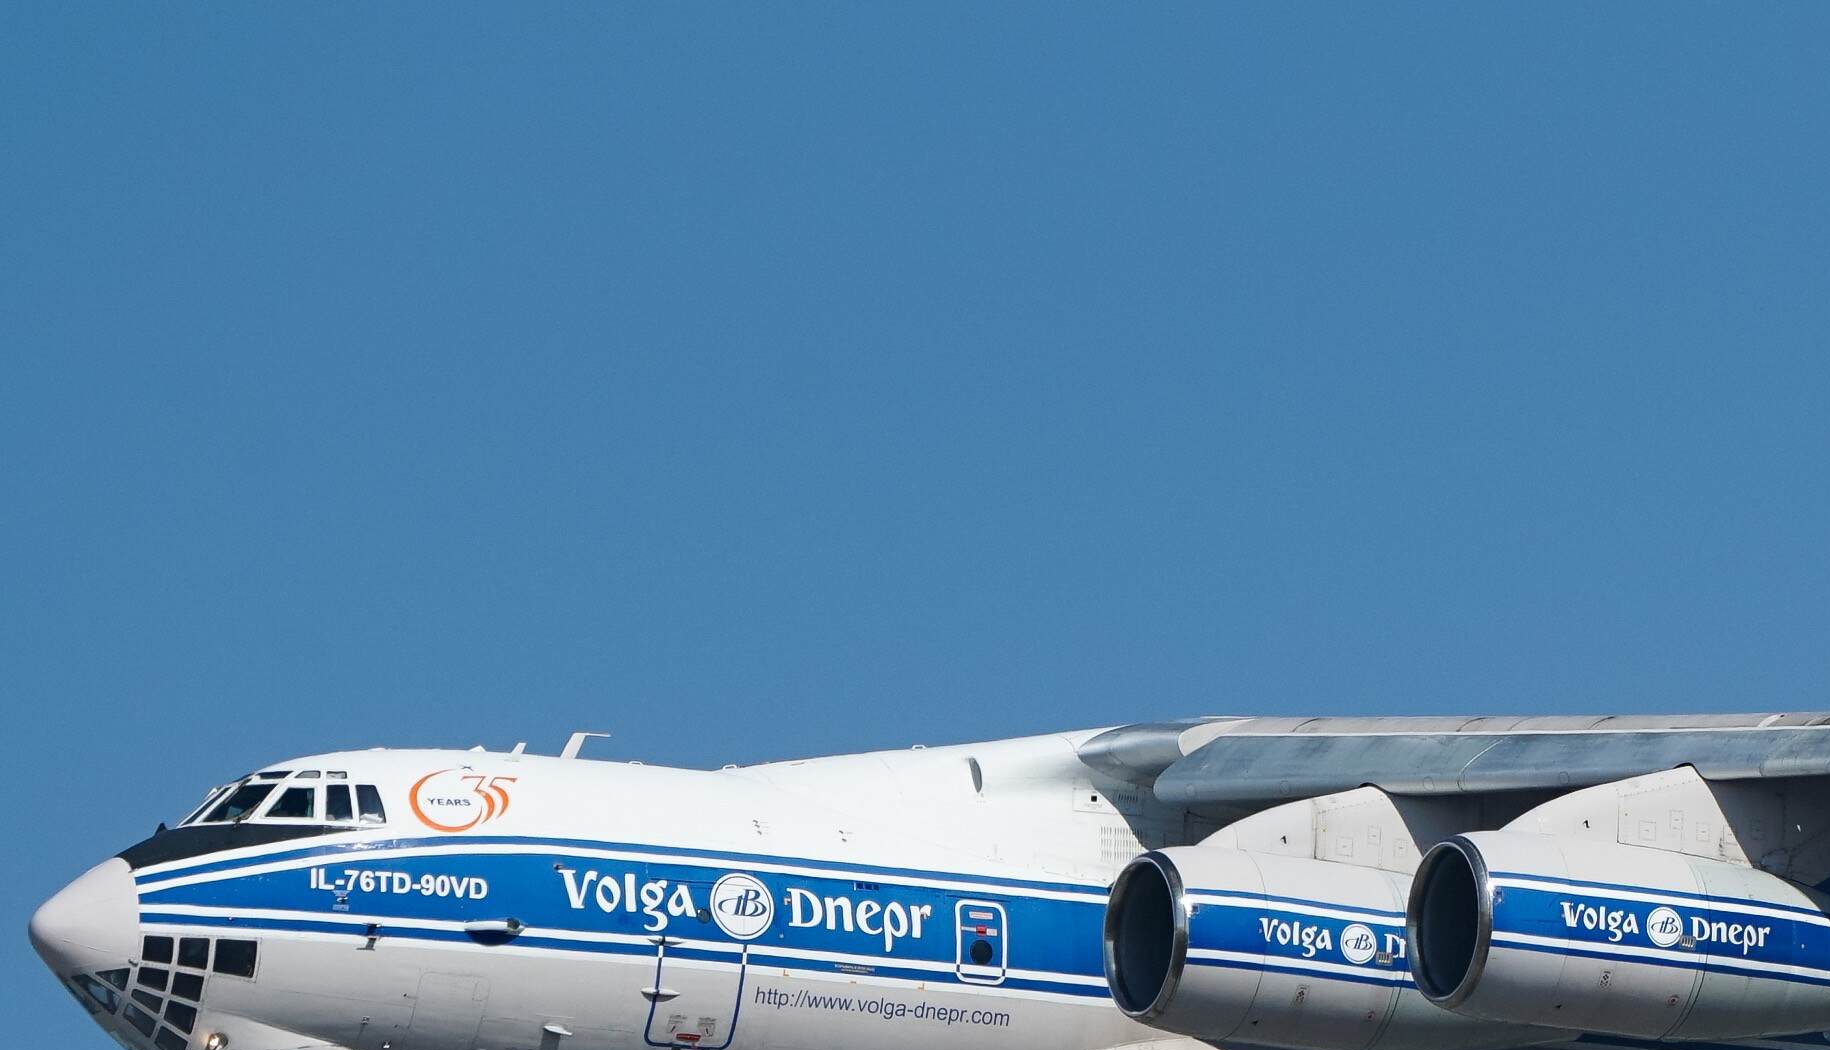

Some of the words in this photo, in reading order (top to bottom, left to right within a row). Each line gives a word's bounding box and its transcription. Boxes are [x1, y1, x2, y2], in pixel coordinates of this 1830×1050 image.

[427, 798, 472, 807] YEARS
[461, 775, 518, 824] 35
[310, 867, 488, 900] IL-76TD-90VD
[557, 868, 698, 932] Volga
[786, 886, 932, 953] Dnepr
[1559, 901, 1640, 942] Volga
[1690, 916, 1771, 955] Dnepr
[1258, 917, 1333, 958] Volga
[754, 985, 1011, 1027] http://www.volga-dnepr.com
